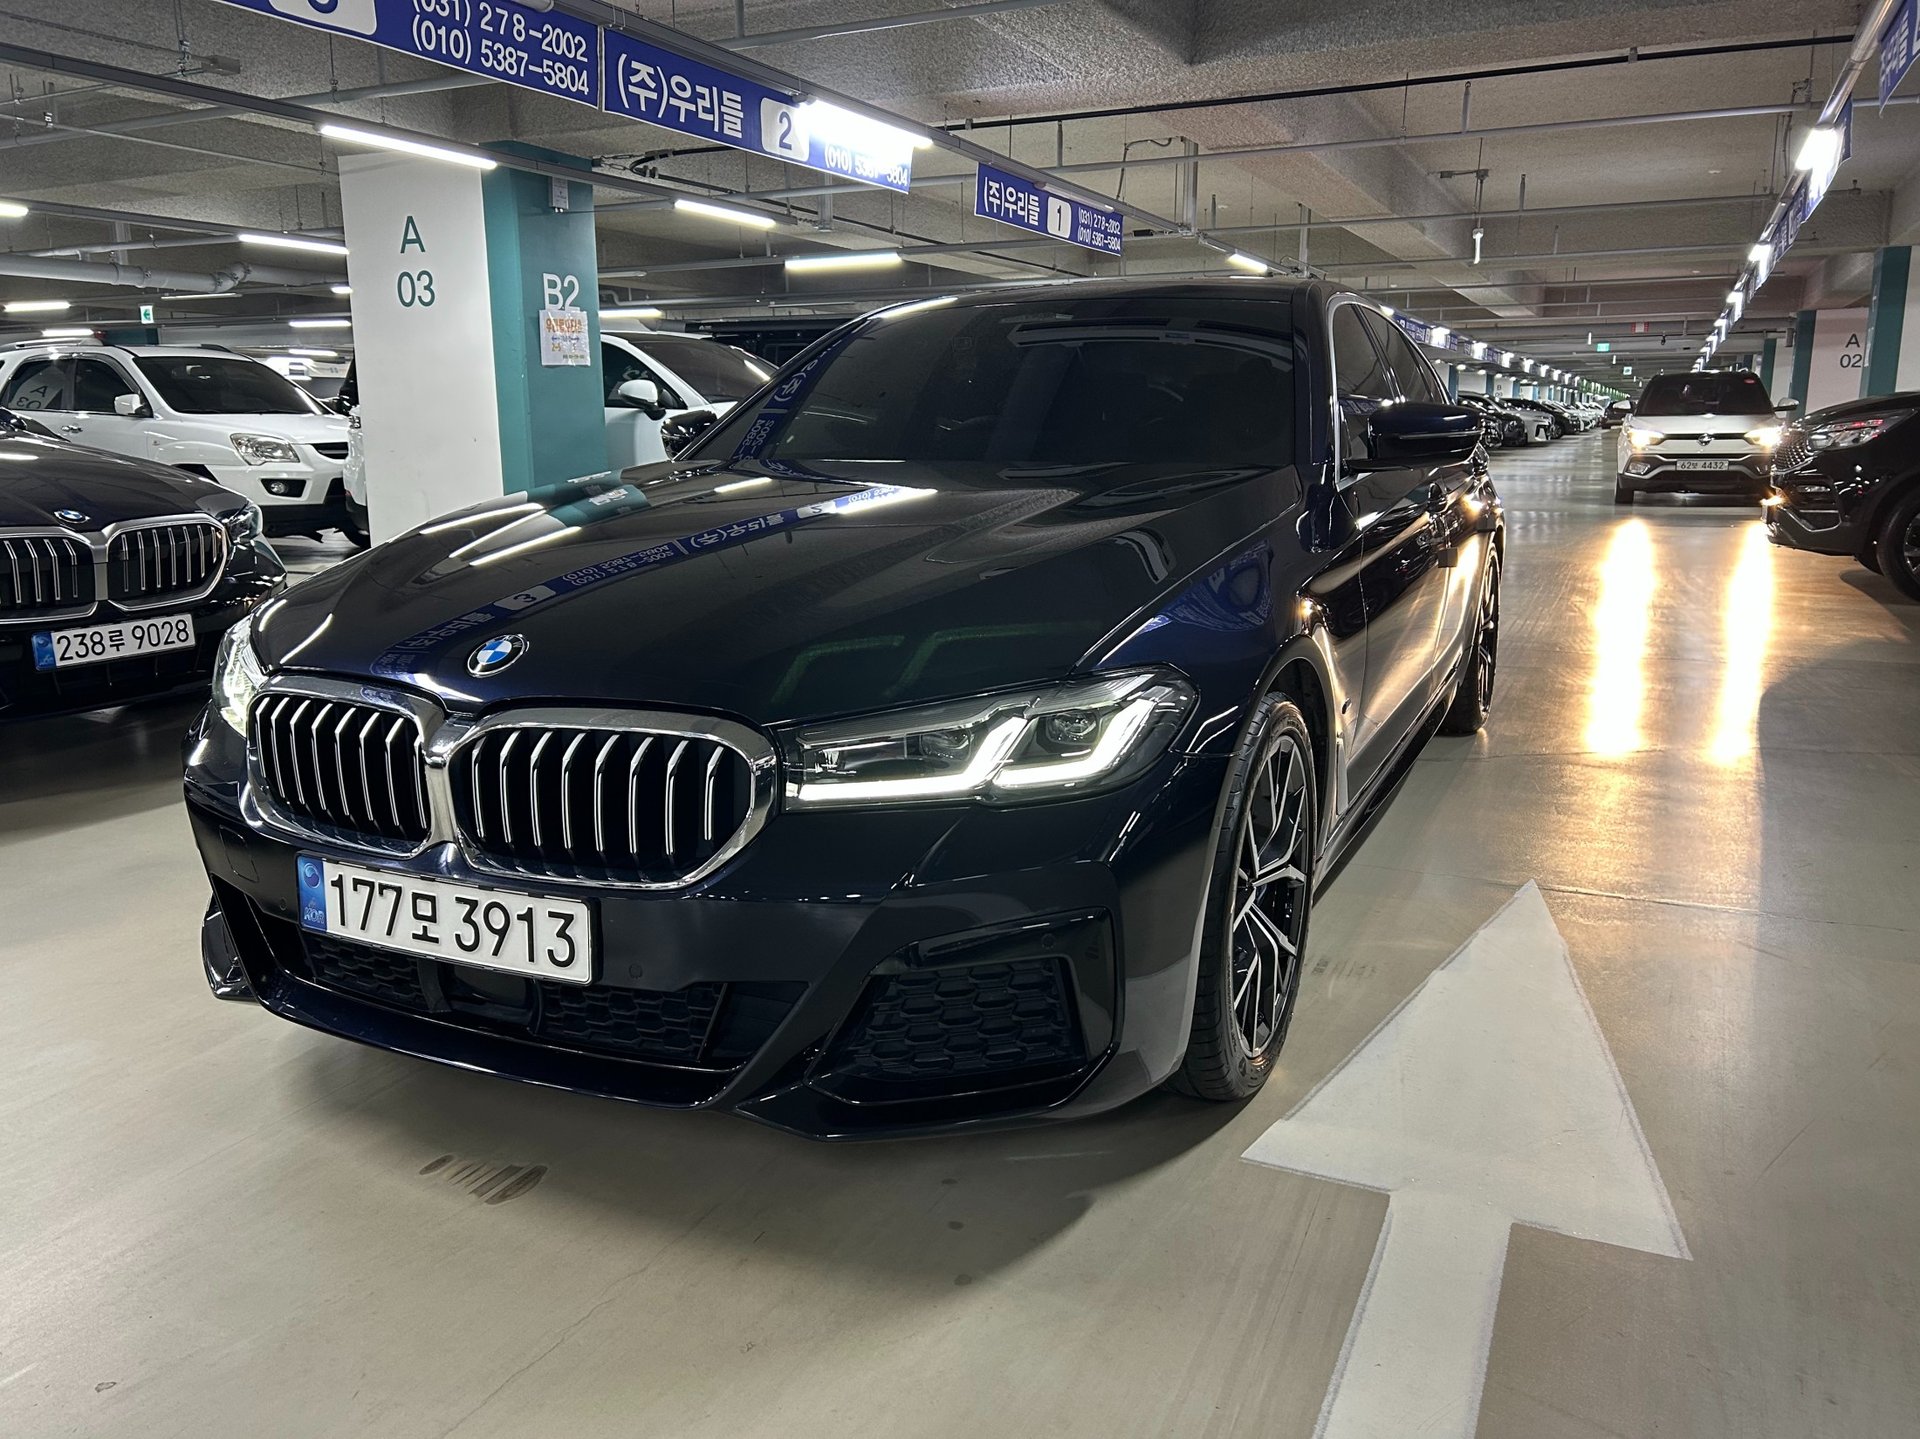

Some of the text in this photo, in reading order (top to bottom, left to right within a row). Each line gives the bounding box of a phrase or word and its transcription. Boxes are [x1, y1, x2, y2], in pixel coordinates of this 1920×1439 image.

[479, 1, 589, 62] 278-2002
[412, 14, 589, 96] (010) 5387-5804
[617, 53, 744, 139] (주)우리들
[778, 111, 793, 150] 2
[824, 144, 852, 174] (010)
[984, 176, 1040, 226] (주)우리들
[1056, 205, 1062, 231] 1
[1078, 206, 1093, 227] (031)
[400, 216, 426, 254] A
[1077, 224, 1092, 245] (010)
[397, 270, 436, 308] 03
[543, 272, 580, 310] B2
[1845, 333, 1860, 348] A
[1840, 354, 1862, 368] 02
[1701, 461, 1724, 470] 4432
[56, 619, 190, 662] 238루 9028
[330, 873, 576, 969] 177모 3913
